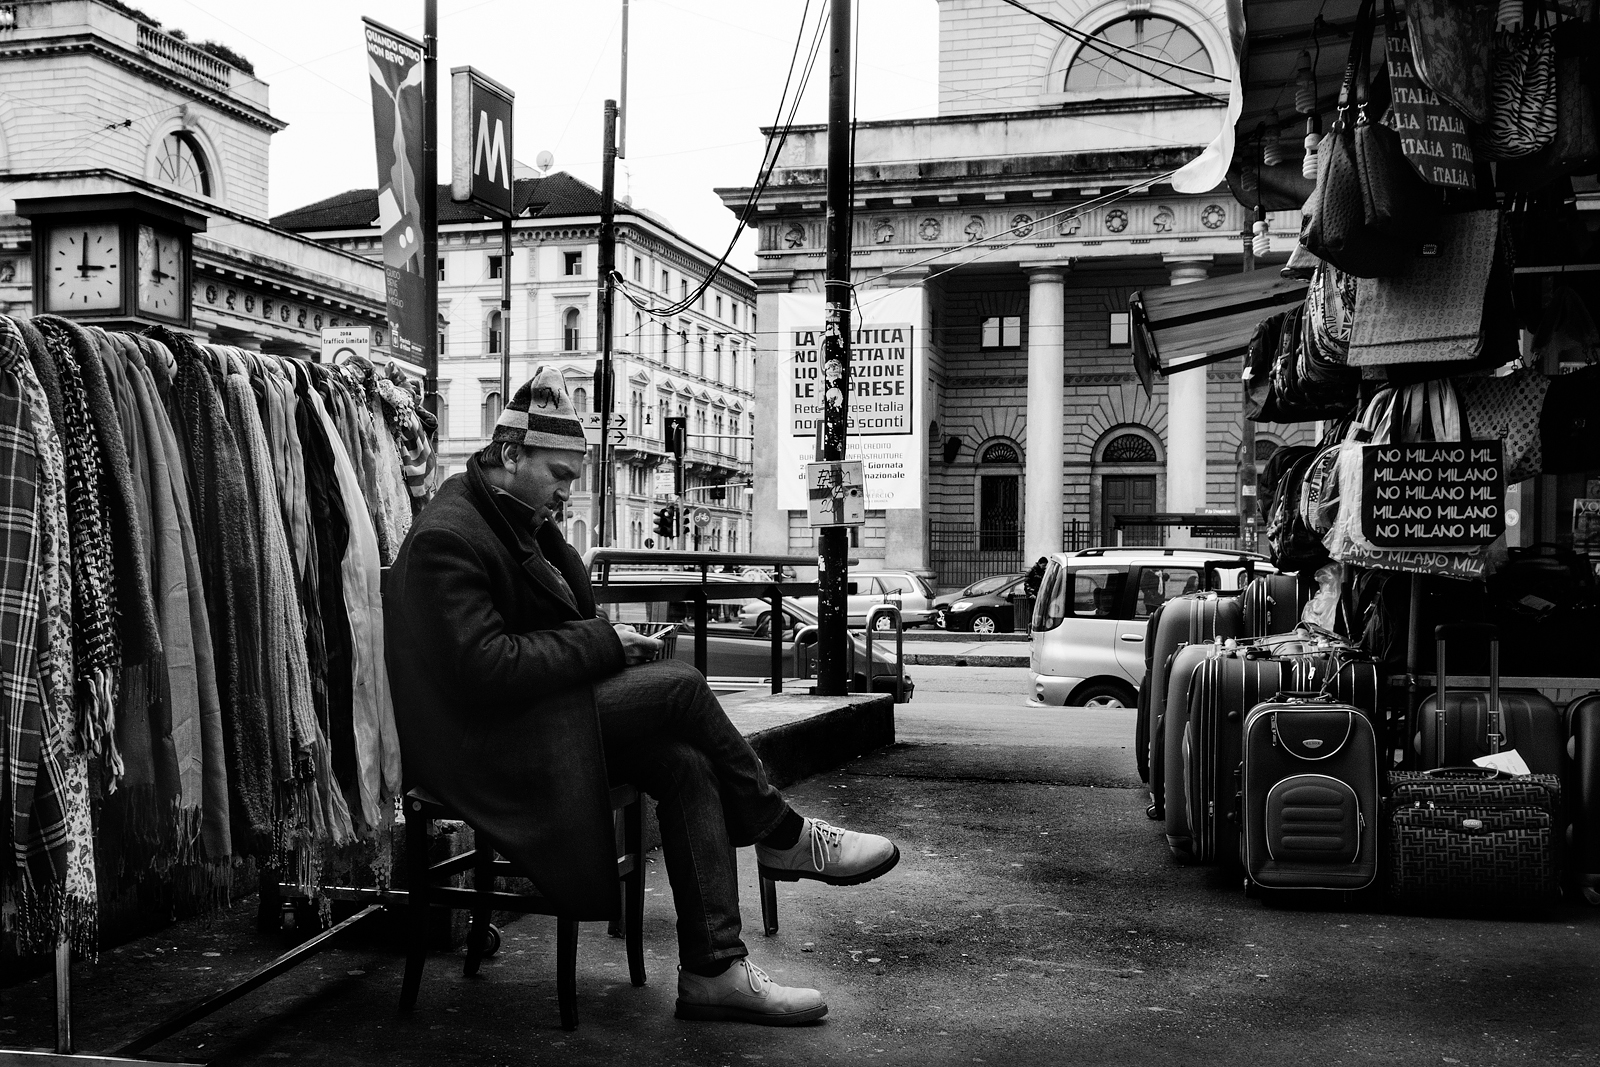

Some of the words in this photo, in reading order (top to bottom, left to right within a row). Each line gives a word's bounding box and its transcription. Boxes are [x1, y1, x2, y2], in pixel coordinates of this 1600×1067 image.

[366, 30, 397, 52] QUANDO
[398, 44, 420, 62] GUIDO
[367, 42, 384, 58] NON
[385, 49, 404, 66] BEVO
[474, 110, 509, 190] M
[795, 332, 815, 346] LA
[850, 328, 904, 345] ITICA
[795, 350, 818, 363] NO
[850, 348, 884, 362] ETTA
[888, 347, 905, 360] IN
[795, 382, 814, 398] LE
[794, 404, 821, 414] Rete
[875, 401, 904, 412] Italia
[858, 415, 903, 428] sconti
[864, 442, 892, 450] CREDITO
[1377, 449, 1401, 462] NO
[1406, 448, 1465, 463] MILANO
[1470, 448, 1498, 463] MIL
[798, 472, 806, 480] di
[1374, 468, 1432, 482] MILANO
[1438, 468, 1498, 482] MILANO
[1376, 486, 1400, 500] NO
[1406, 486, 1465, 500] MILANO
[1470, 486, 1497, 500] MIL
[1373, 505, 1432, 520] MILANO
[1438, 505, 1498, 520] MILANO
[1376, 524, 1400, 538] NO
[1404, 524, 1465, 538] MILANO
[1470, 524, 1497, 538] MIL
[1388, 551, 1449, 568] MILANO
